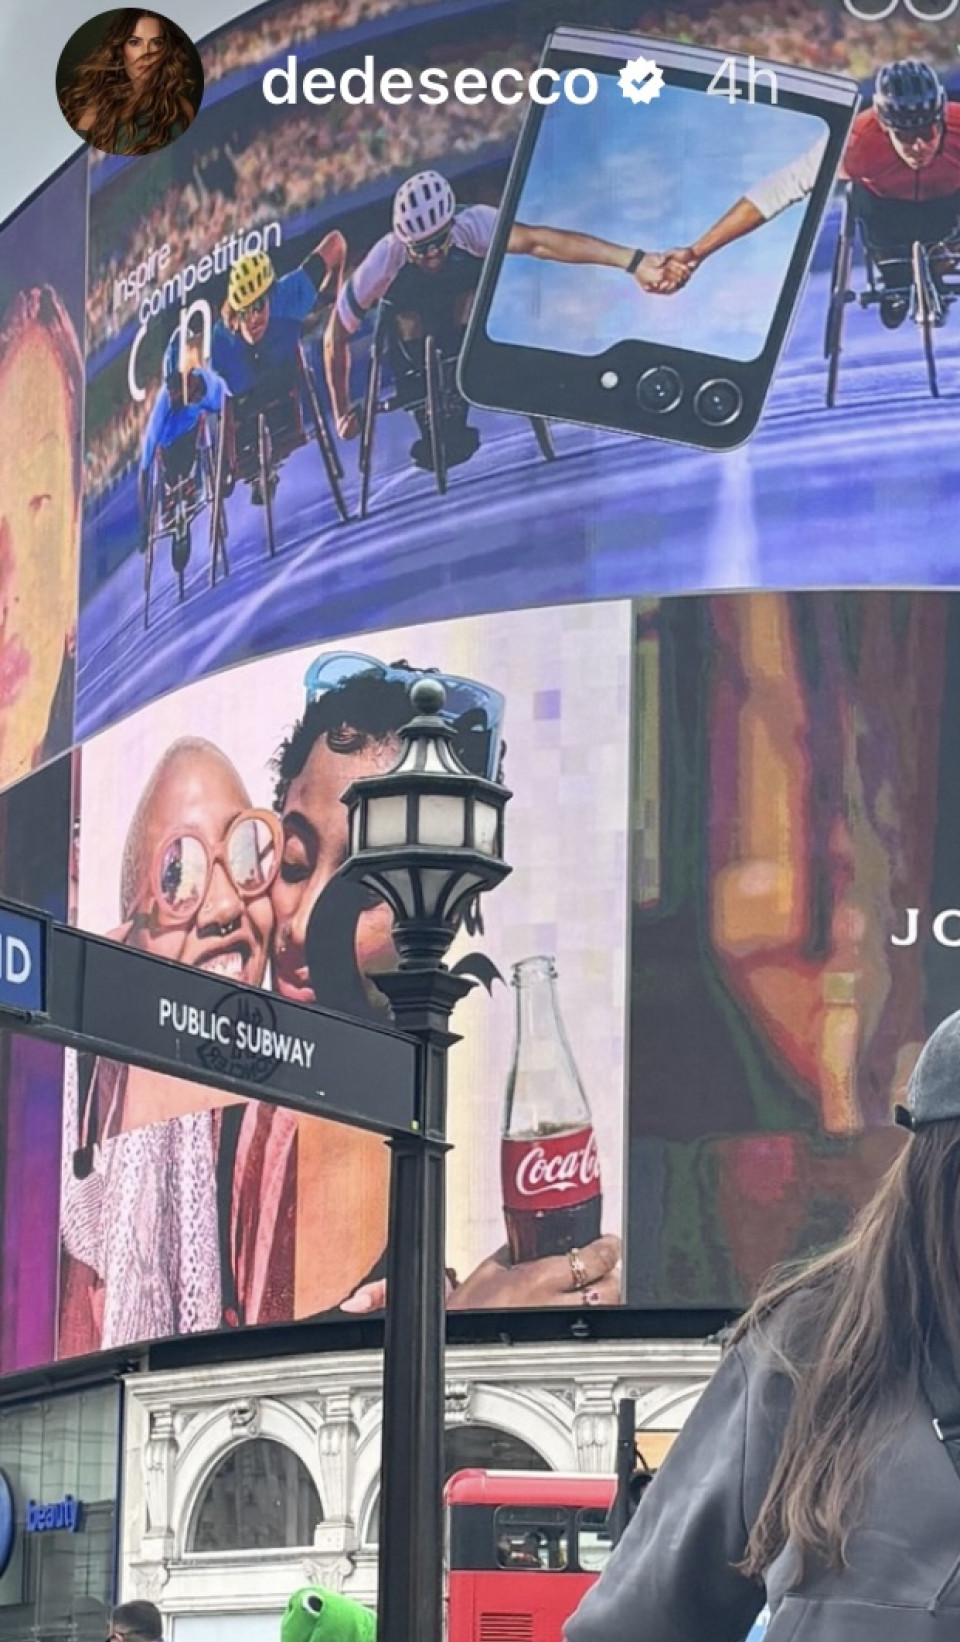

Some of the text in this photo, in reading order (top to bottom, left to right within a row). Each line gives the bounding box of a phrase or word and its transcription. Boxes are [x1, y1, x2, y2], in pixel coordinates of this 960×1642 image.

[139, 221, 282, 325] competition
[0, 935, 32, 985] D
[159, 998, 231, 1045] PUBLIC
[235, 1019, 316, 1069] SUBWAY
[26, 1493, 84, 1534] beauty
